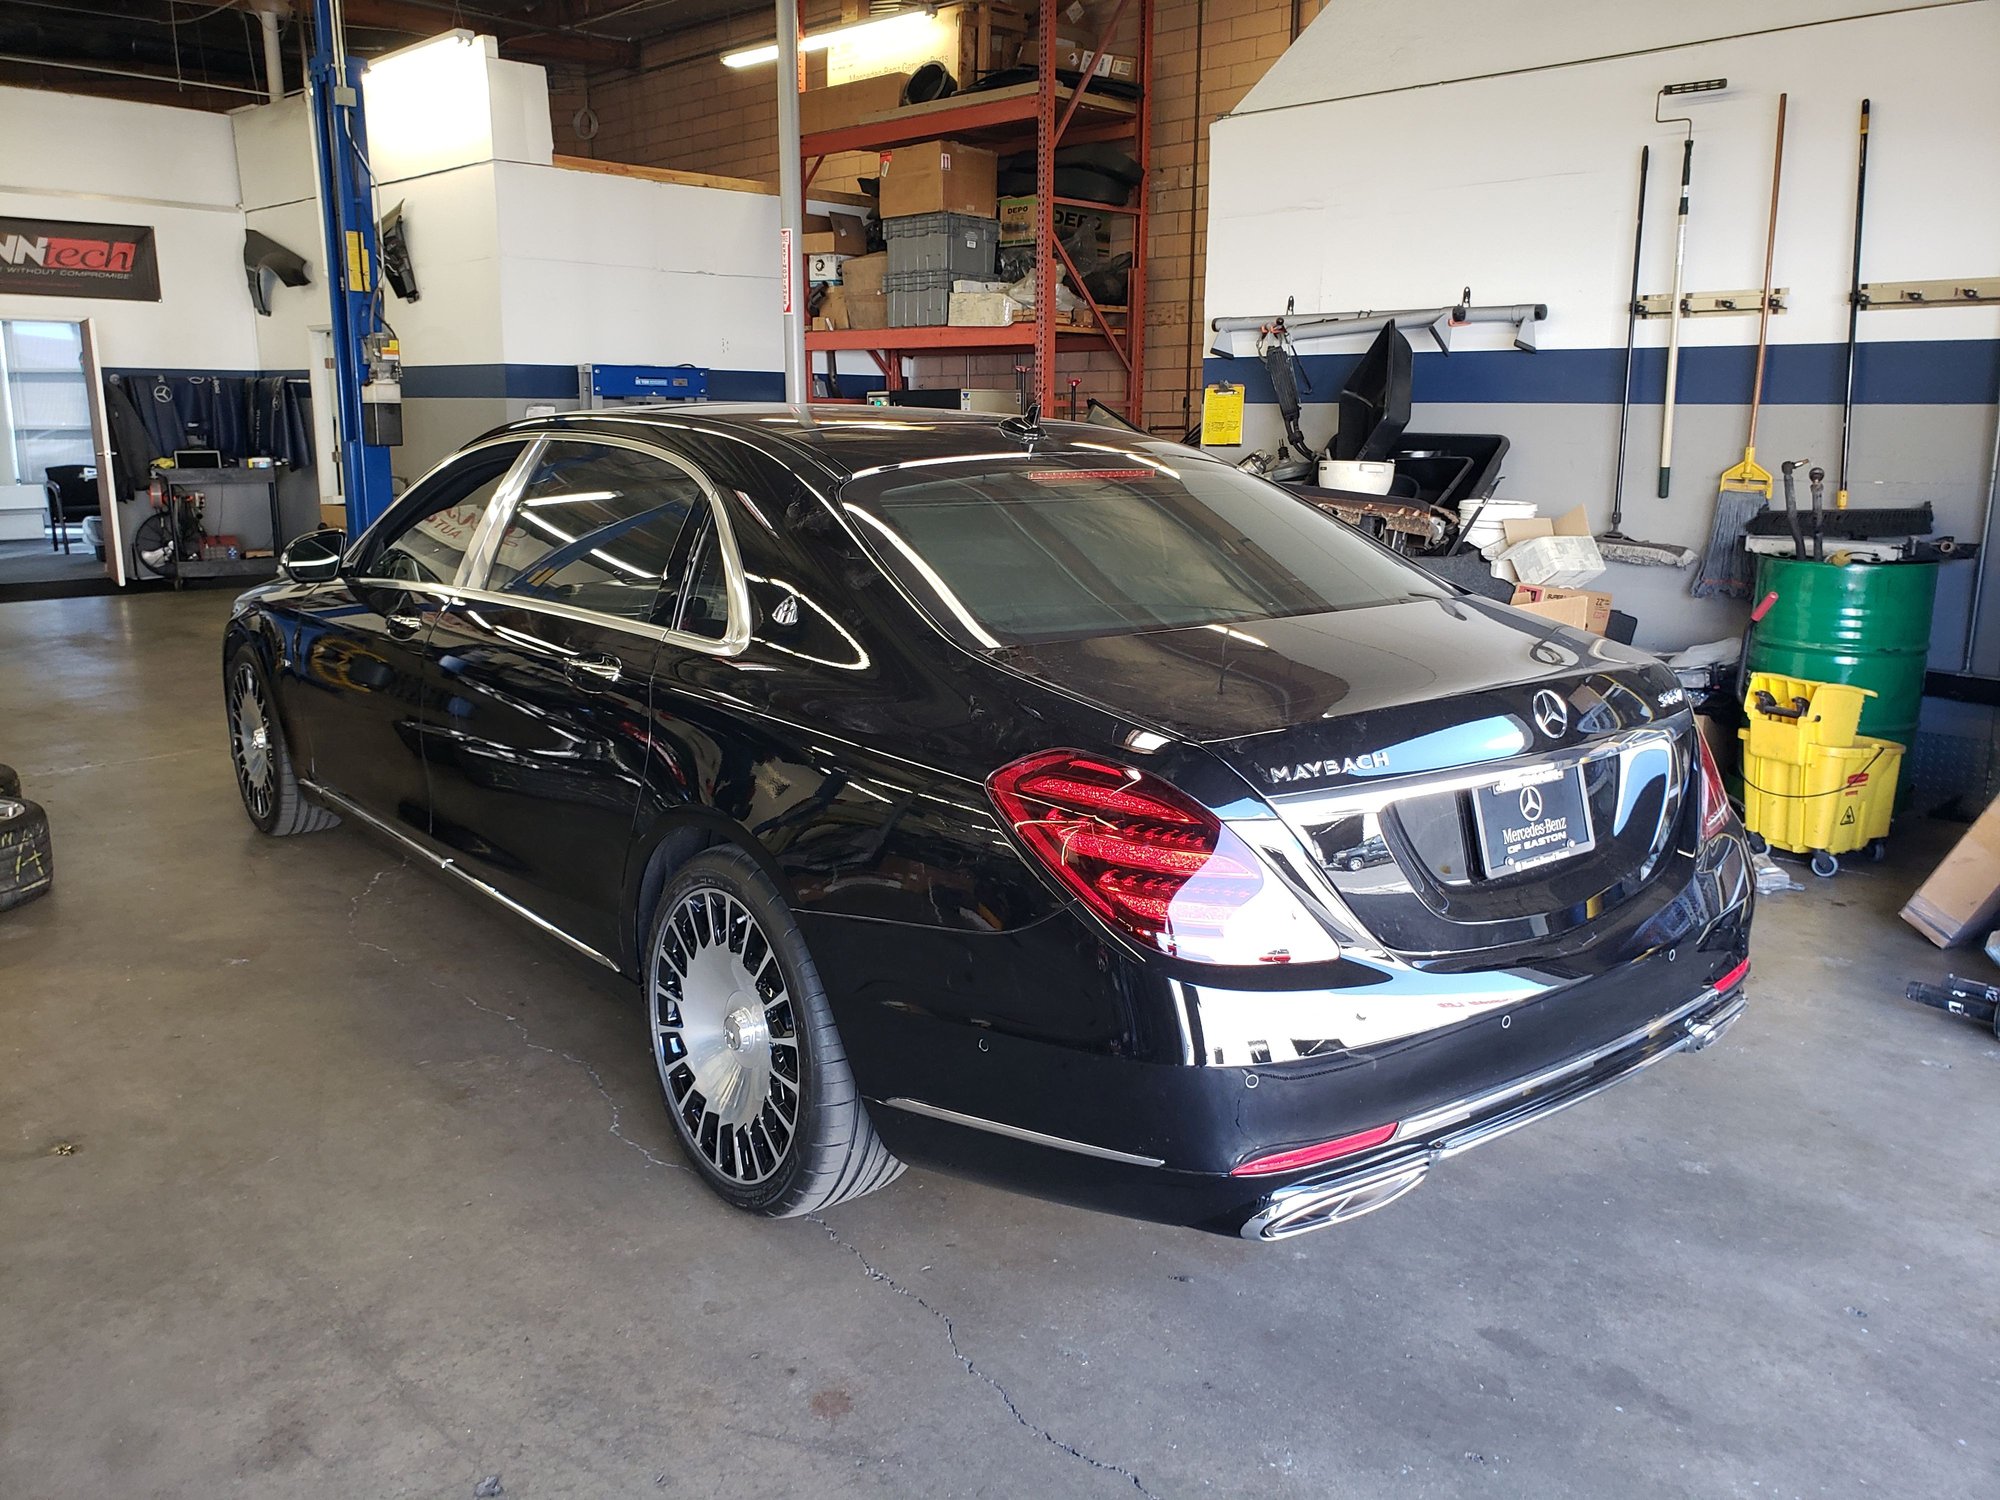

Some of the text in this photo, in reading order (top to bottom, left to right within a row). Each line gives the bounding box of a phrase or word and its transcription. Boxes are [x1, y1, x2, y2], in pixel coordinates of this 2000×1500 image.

[1007, 205, 1029, 215] DEPO
[7, 267, 130, 280] WITHOUT COMPROMISE
[1270, 751, 1390, 783] MAYBACH
[1502, 817, 1567, 845] Mercedes-Benz
[1507, 831, 1567, 855] OF EASTON
